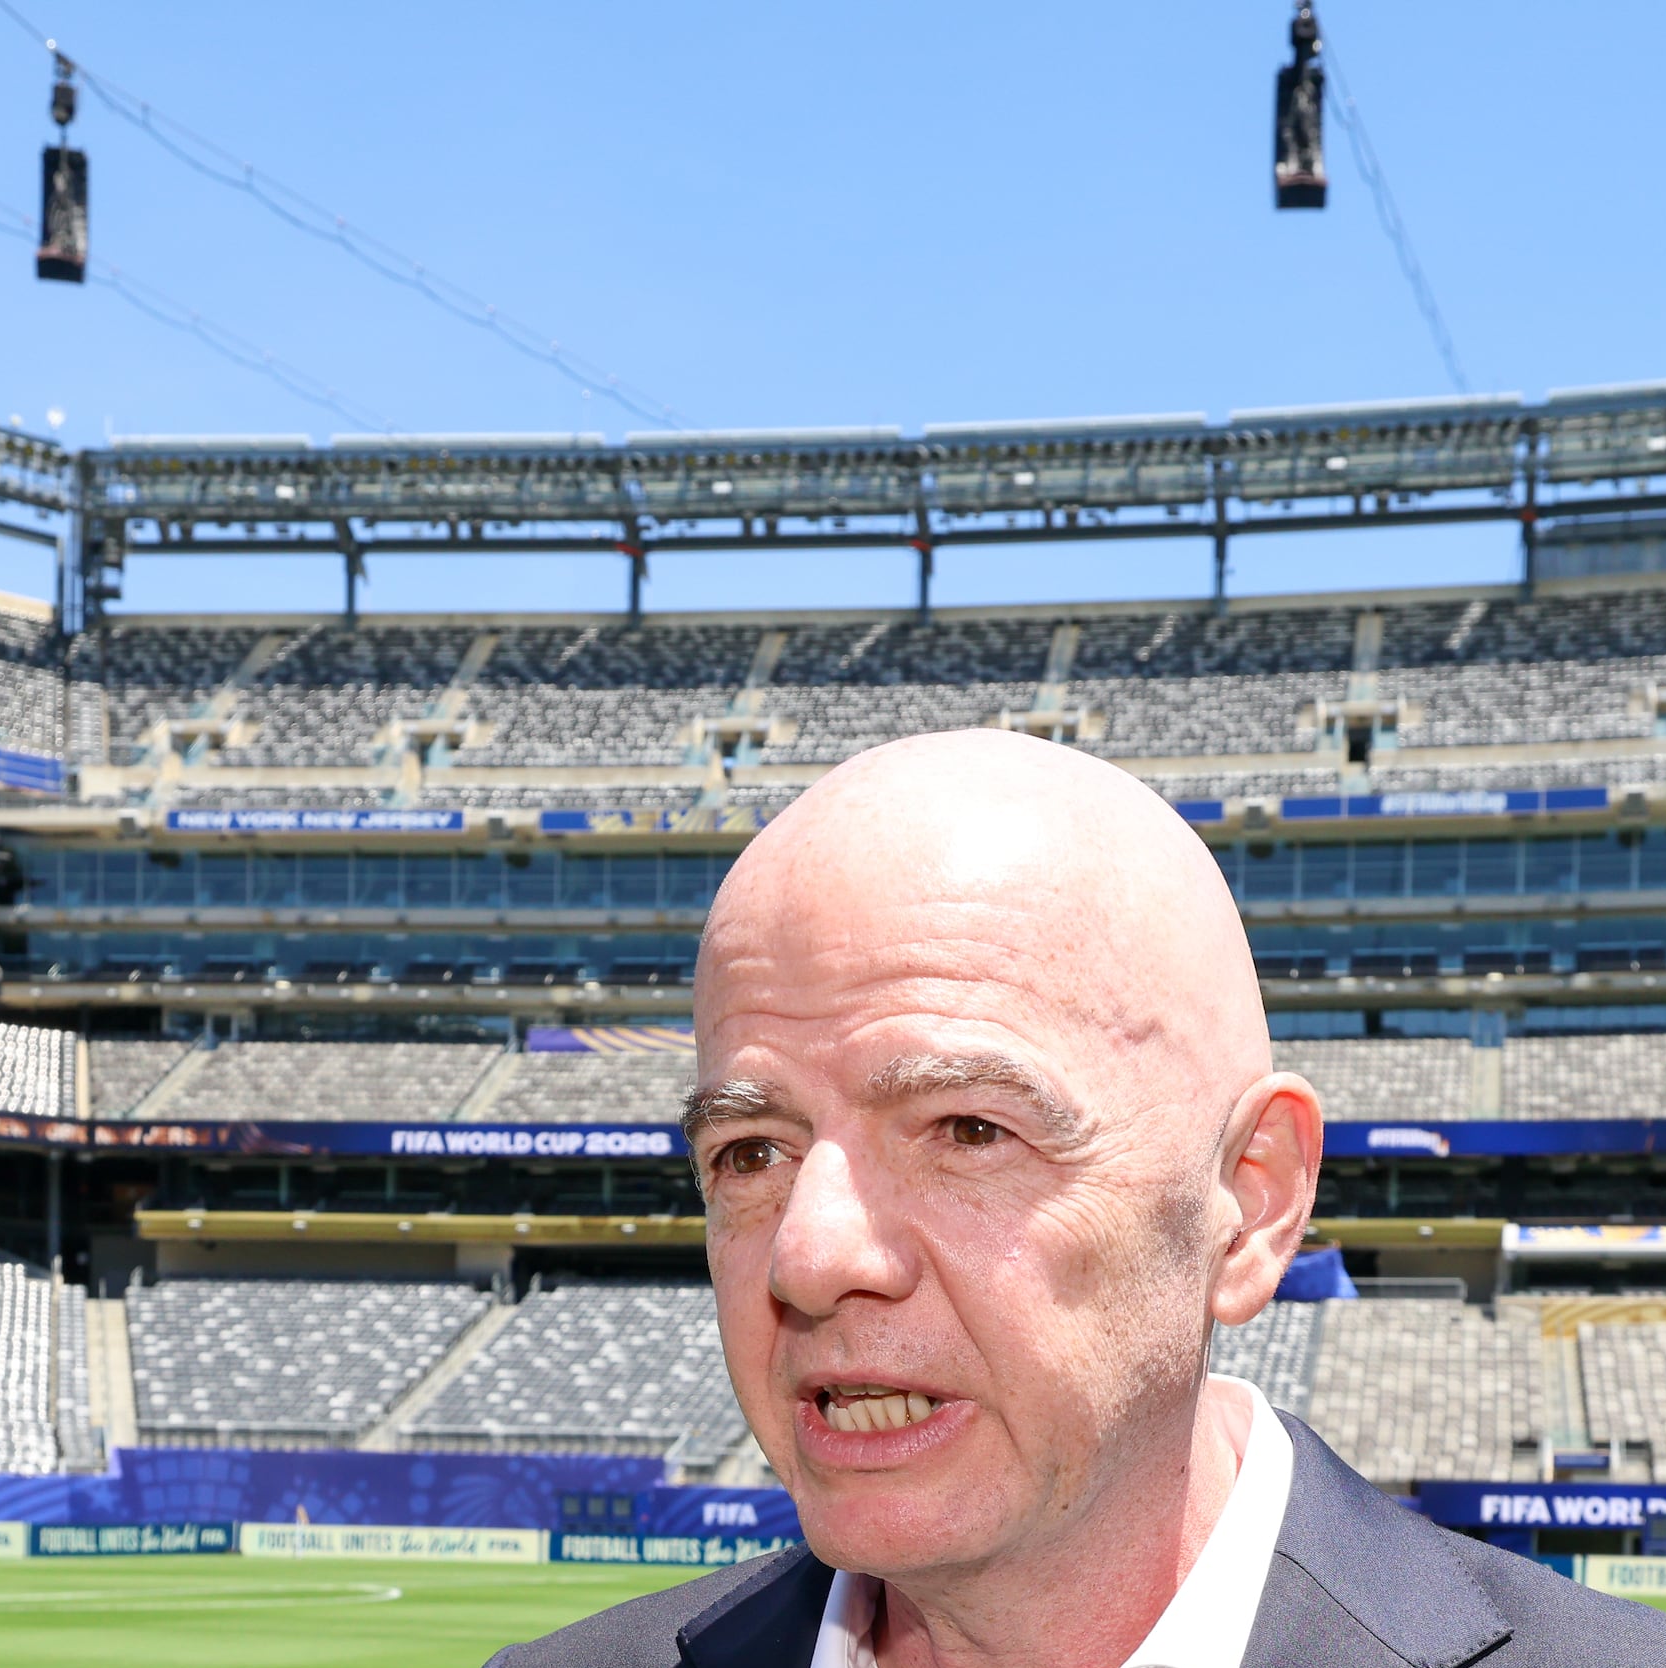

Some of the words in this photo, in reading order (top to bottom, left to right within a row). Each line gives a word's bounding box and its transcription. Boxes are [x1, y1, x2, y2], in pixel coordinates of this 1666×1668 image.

[178, 811, 232, 828] NEW
[234, 811, 299, 828] YORK
[302, 811, 357, 828] NEW
[359, 811, 453, 828] JERSEY
[391, 1130, 445, 1154] FIFA
[445, 1131, 533, 1155] WORLD
[534, 1131, 584, 1155] CUP
[584, 1131, 672, 1156] 2026
[702, 1502, 758, 1526] FIFA
[1480, 1494, 1552, 1525] FIFA
[39, 1526, 97, 1553] FOOTBALL
[98, 1526, 139, 1553] UNITES
[258, 1529, 334, 1551] FOOTBALL
[341, 1530, 392, 1551] UNITES
[562, 1535, 641, 1562] FOOTBALL
[643, 1537, 701, 1563] UNITES
[703, 1536, 733, 1565] the
